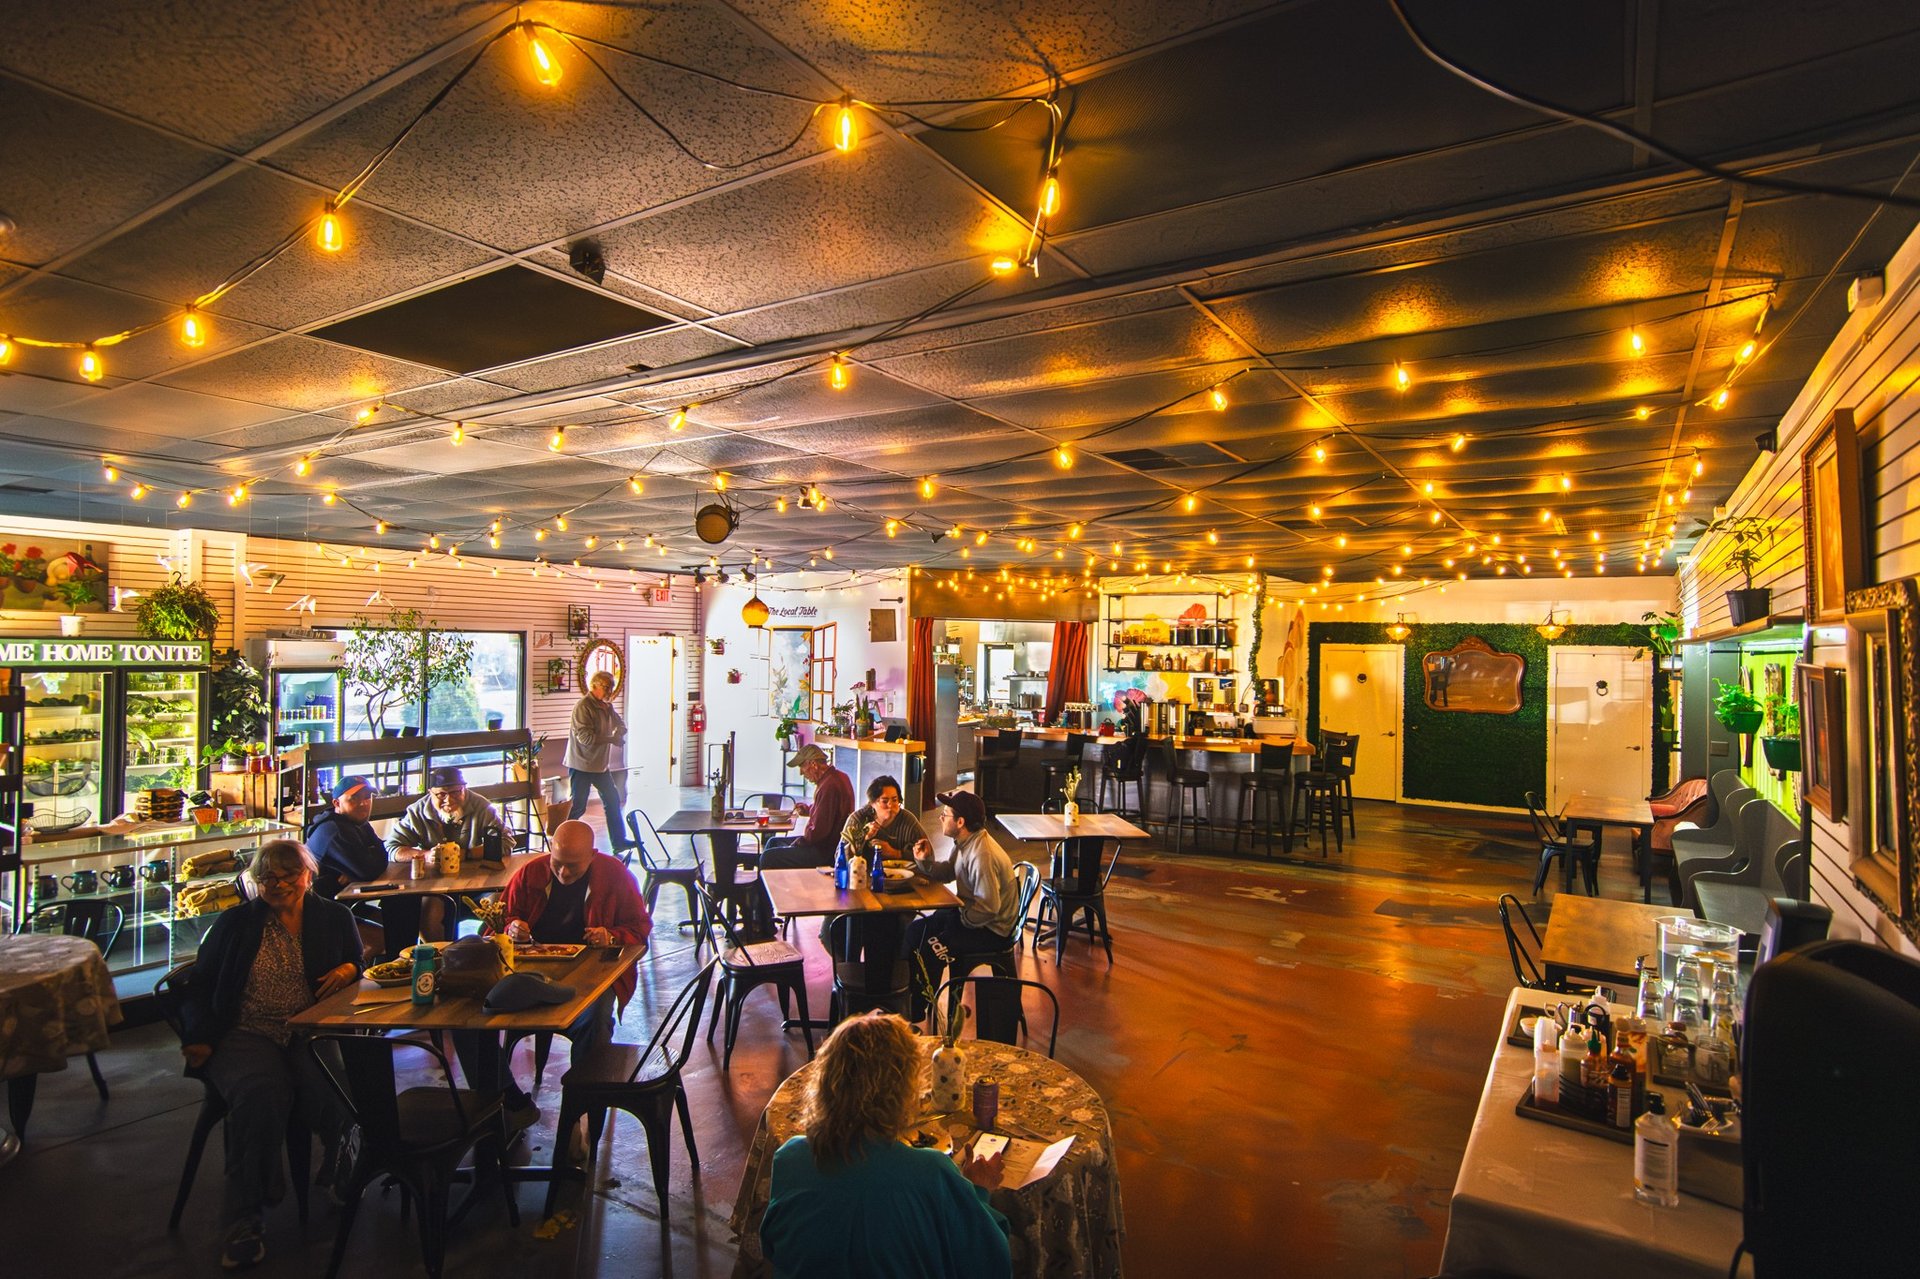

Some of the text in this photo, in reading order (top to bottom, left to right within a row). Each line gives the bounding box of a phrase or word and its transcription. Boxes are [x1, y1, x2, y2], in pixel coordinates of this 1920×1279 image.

[656, 589, 669, 601] EXIT
[769, 606, 779, 615] The
[780, 606, 798, 617] Local
[799, 606, 818, 615] Table
[42, 644, 113, 662] HOME
[119, 645, 202, 662] TONITE
